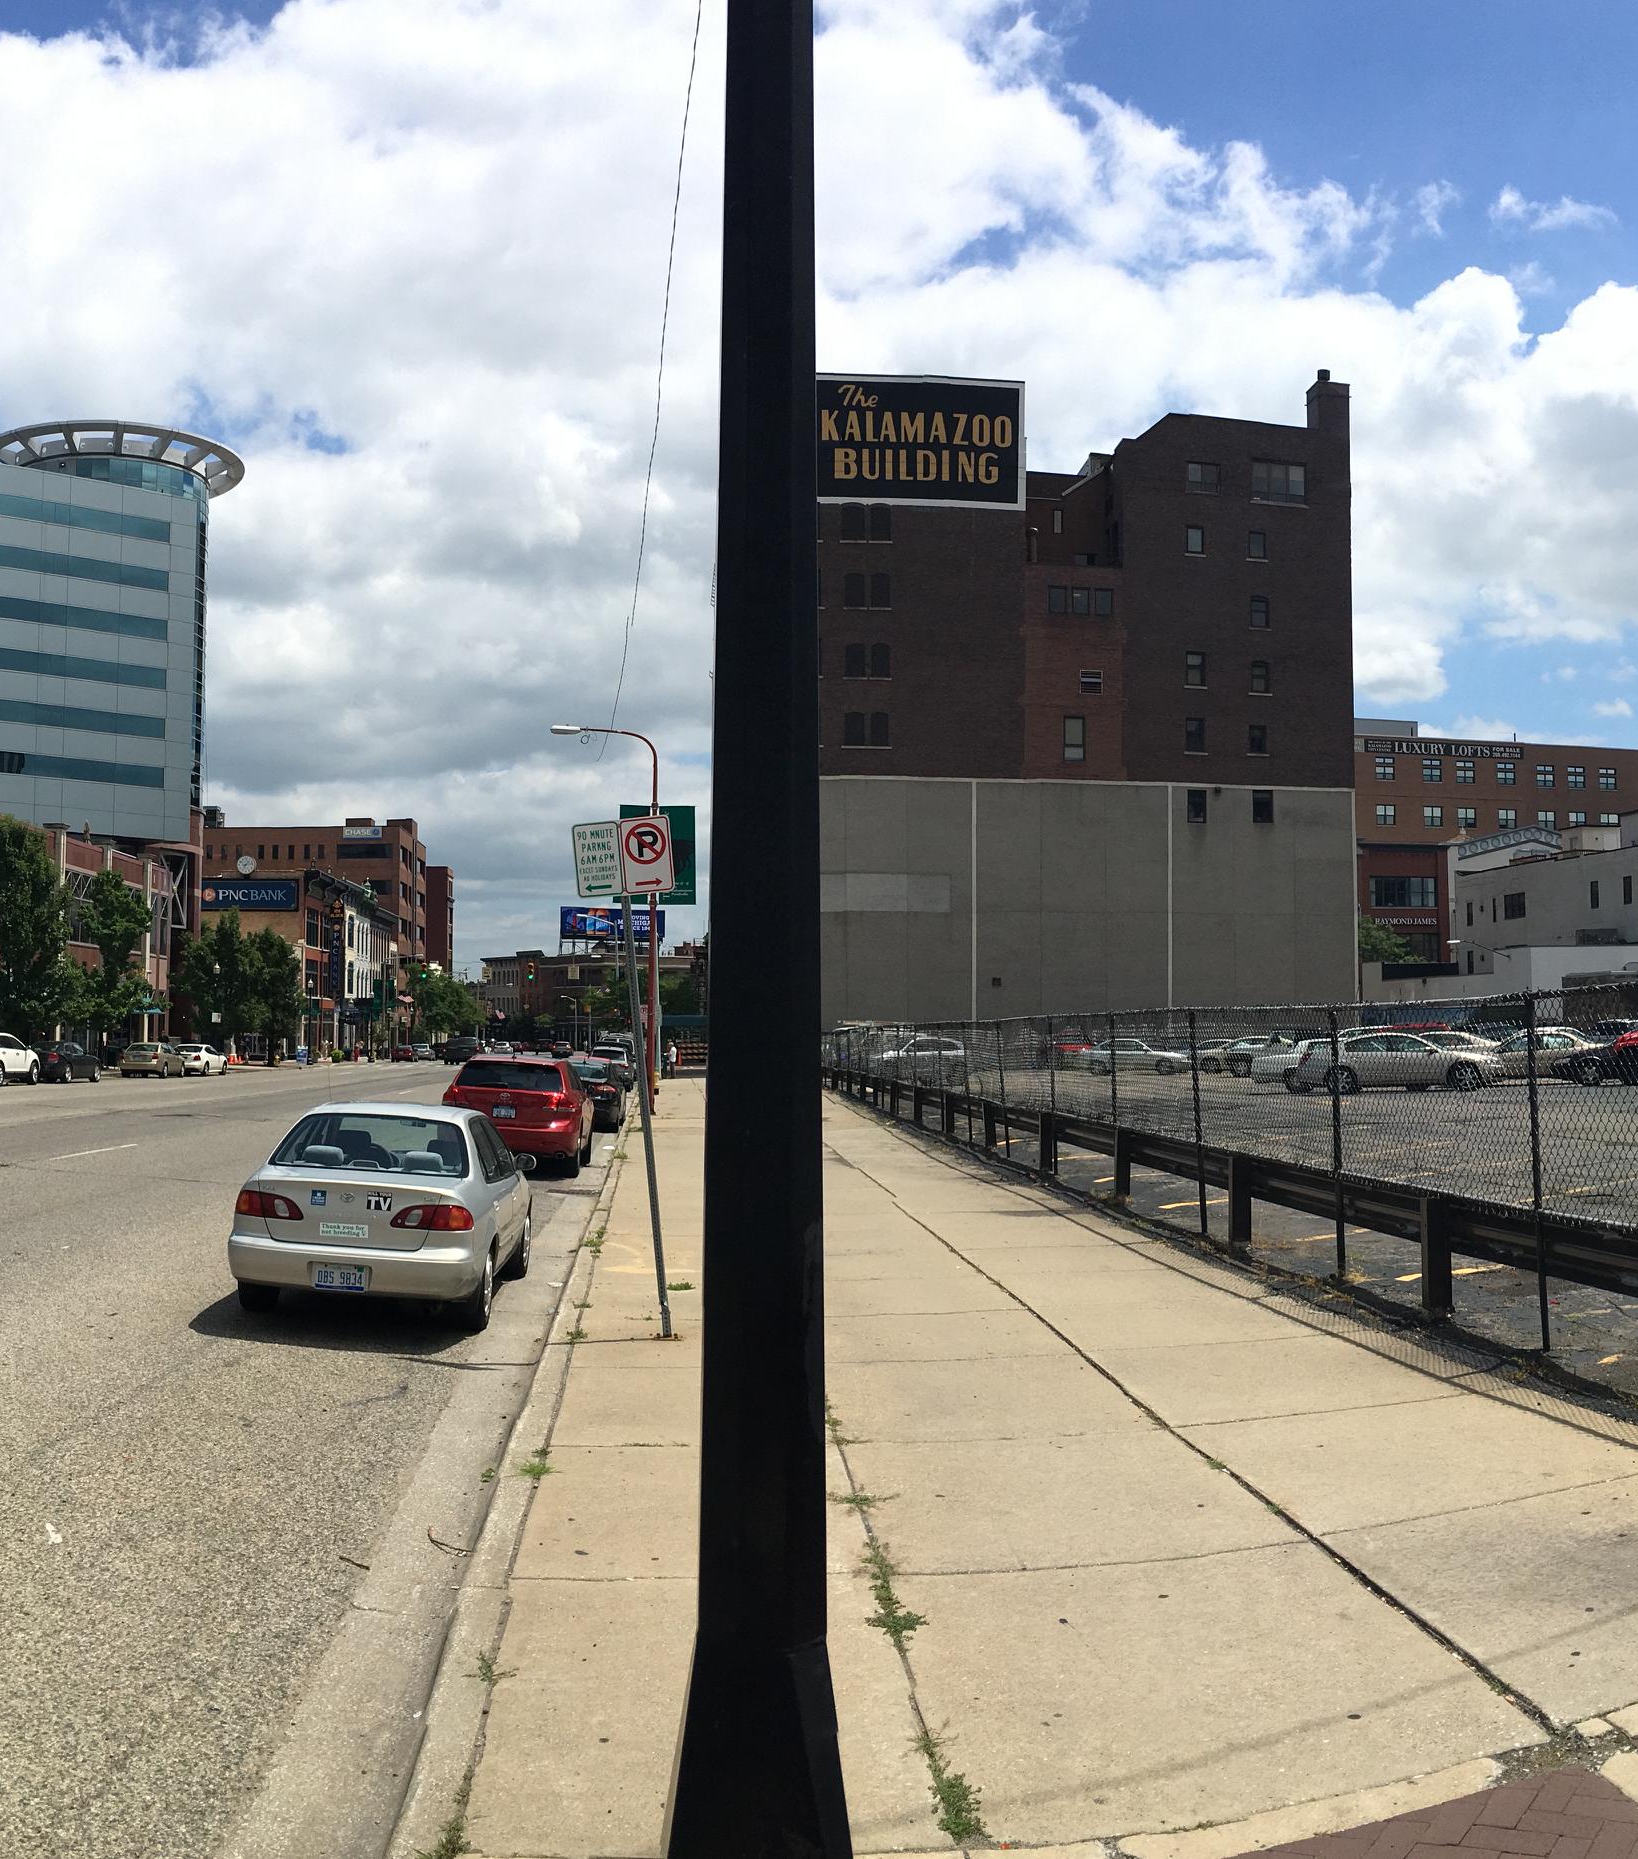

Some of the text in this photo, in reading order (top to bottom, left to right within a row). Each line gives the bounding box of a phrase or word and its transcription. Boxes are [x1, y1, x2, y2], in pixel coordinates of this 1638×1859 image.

[837, 385, 878, 408] The
[821, 409, 1013, 448] KALAMAZOO
[835, 447, 999, 484] BUILDING
[1394, 741, 1446, 755] LUXURY
[1452, 745, 1491, 758] LOFTS
[344, 828, 373, 836] CHASE
[576, 831, 587, 841] 90
[1374, 917, 1437, 925] RAYMOND JAMES
[367, 1196, 392, 1211] TV
[317, 1270, 363, 1286] DBS 9834
